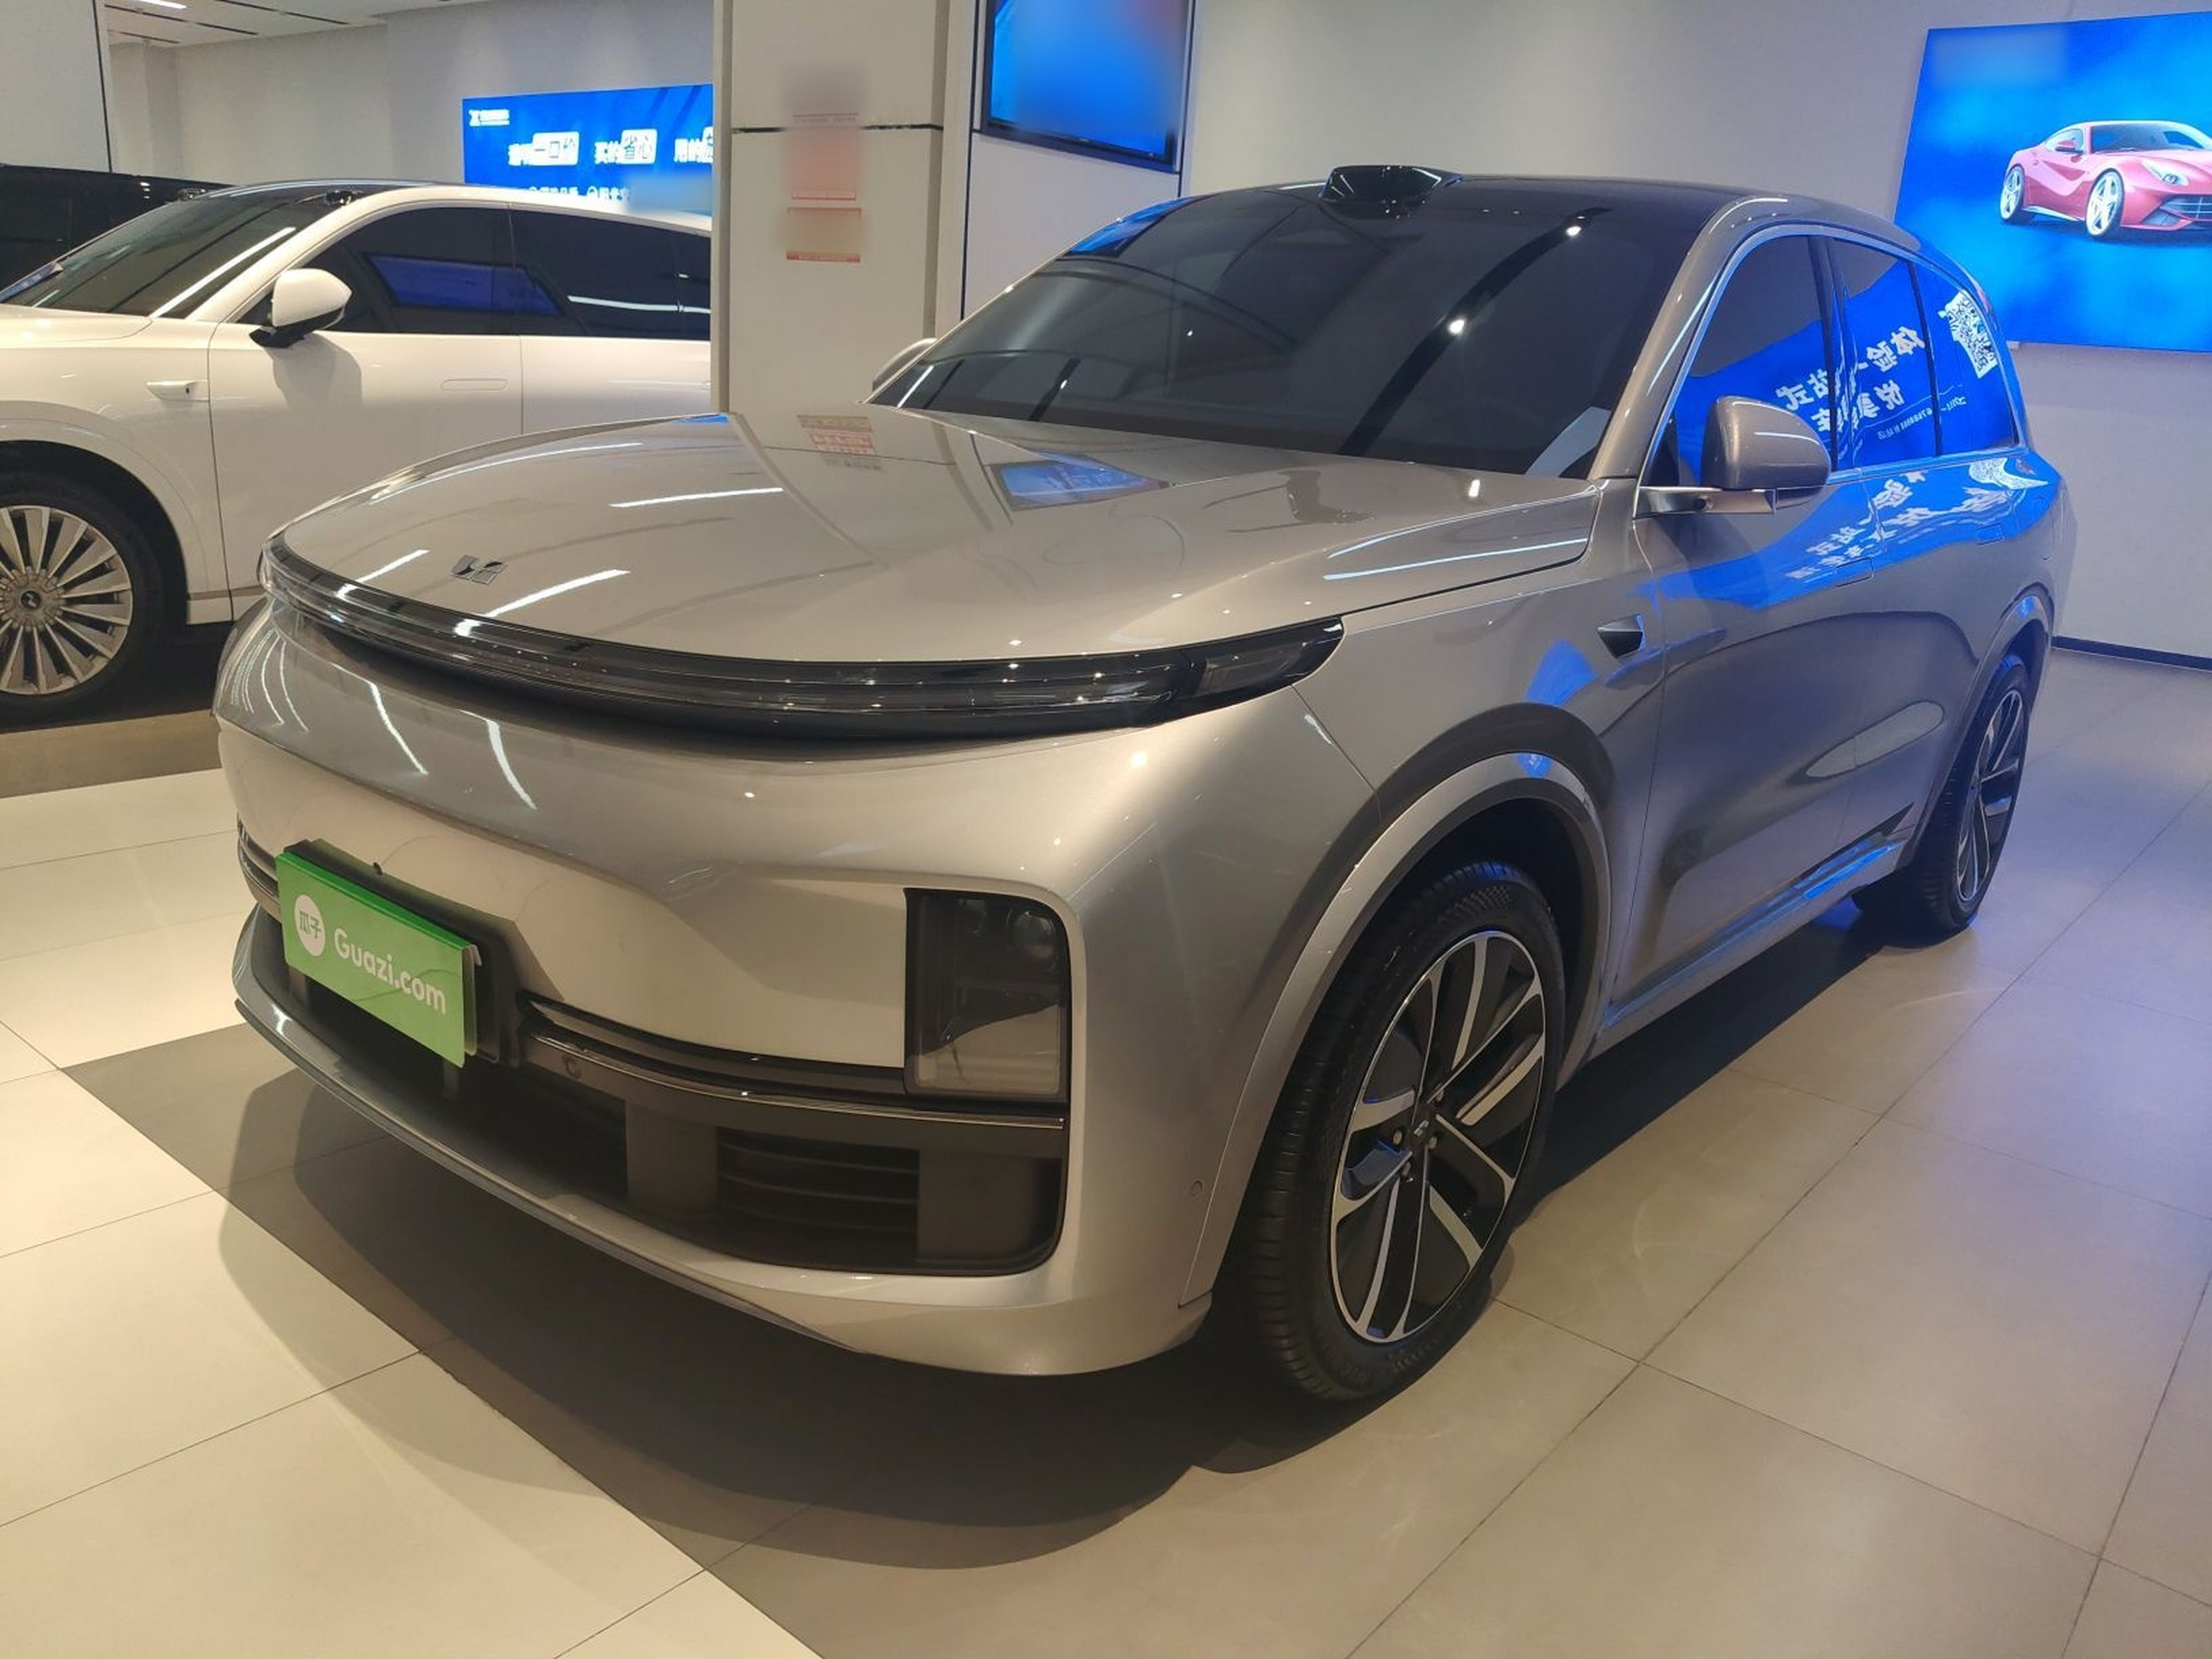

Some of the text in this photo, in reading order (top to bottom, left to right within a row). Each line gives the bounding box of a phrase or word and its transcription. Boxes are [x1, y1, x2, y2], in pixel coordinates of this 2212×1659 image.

[508, 135, 577, 165] 一口价
[298, 910, 322, 940] 瓜子
[334, 927, 446, 1014] Guazi.com
